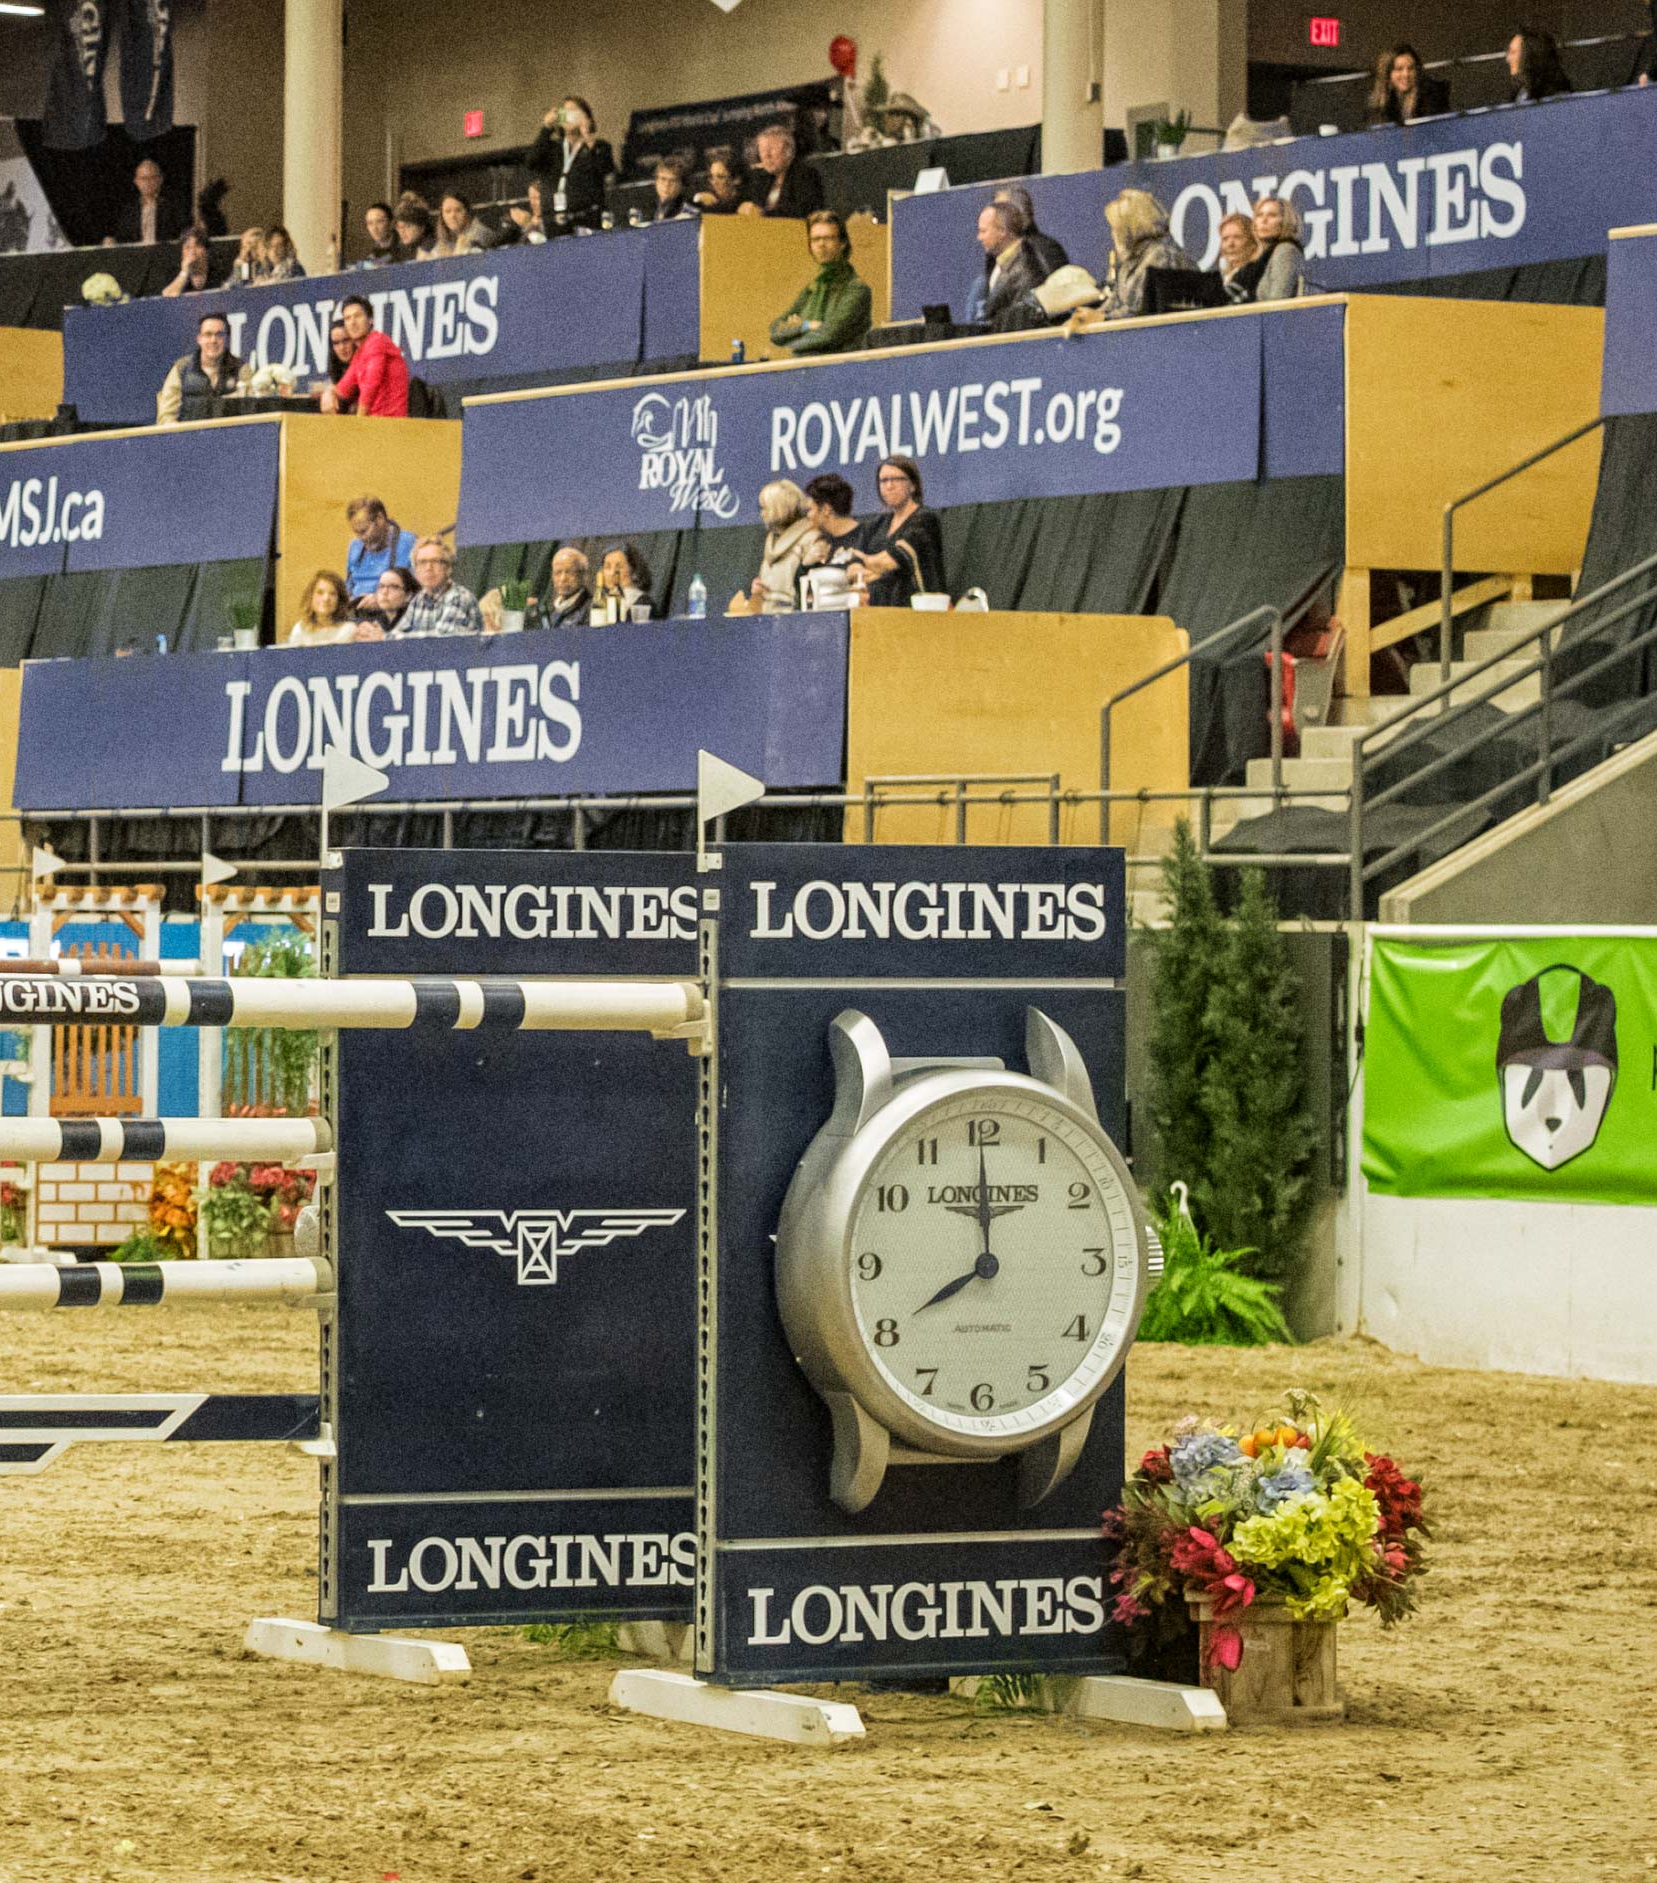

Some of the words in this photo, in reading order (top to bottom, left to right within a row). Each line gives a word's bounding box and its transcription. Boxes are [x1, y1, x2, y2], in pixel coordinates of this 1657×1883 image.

[769, 378, 1124, 472] ROYALWEST.org
[639, 447, 725, 489] ROYAL
[221, 660, 582, 773] LONGINES
[368, 883, 698, 940] LONGINES
[749, 881, 1106, 943] LONGINES
[967, 1118, 1001, 1147] 12
[917, 1137, 938, 1165] 11
[1036, 1137, 1046, 1164] 1
[876, 1184, 910, 1213] 10
[1068, 1182, 1091, 1209] 2
[857, 1252, 883, 1281] 9
[1080, 1248, 1107, 1277] 3
[873, 1318, 901, 1347] 8
[952, 1322, 1012, 1334] AUTOMATIC
[1061, 1314, 1091, 1342] 4
[915, 1367, 940, 1396] 7
[1026, 1363, 1051, 1393] 5
[970, 1383, 995, 1412] 6
[366, 1532, 695, 1594] LONGINES
[747, 1575, 1106, 1646] LONGINES
